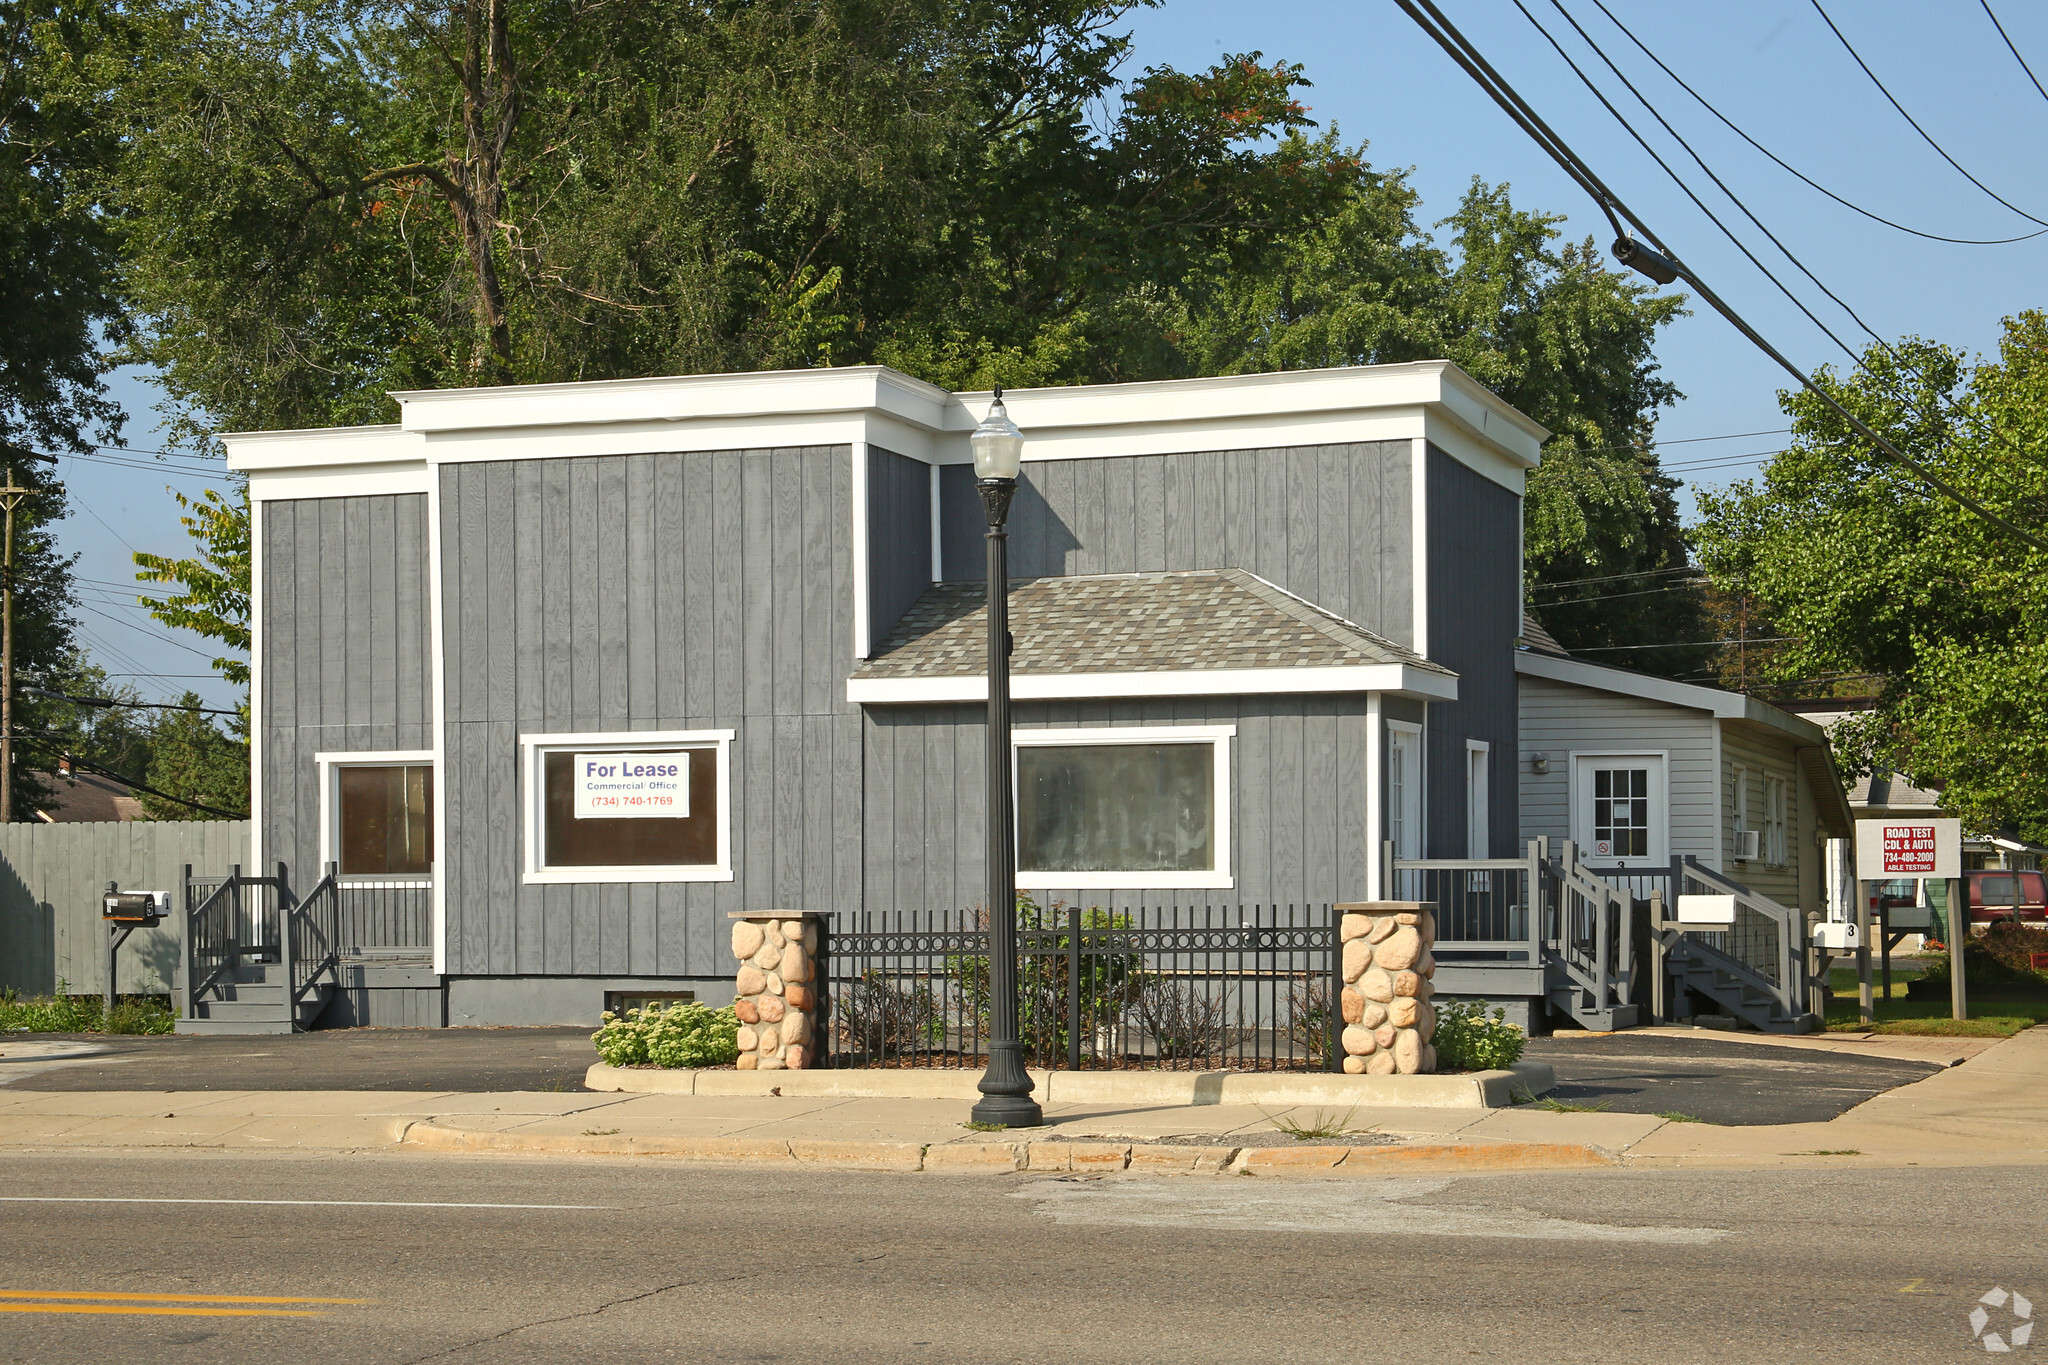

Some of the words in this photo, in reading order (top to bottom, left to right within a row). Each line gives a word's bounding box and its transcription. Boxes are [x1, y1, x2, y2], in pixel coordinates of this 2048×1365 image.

[587, 762, 616, 777] For
[622, 761, 678, 777] Lease
[649, 781, 677, 790] Office
[591, 797, 619, 808] (734)
[623, 796, 673, 806] 740-1769
[1886, 828, 1910, 838] ROAD
[1911, 828, 1932, 838] TEST
[1884, 840, 1902, 850] CDL
[1903, 840, 1911, 850] &
[1912, 839, 1934, 850] AUTO
[1884, 852, 1934, 862] 734-480-2000
[147, 902, 153, 916] 5
[165, 898, 170, 910] 1
[1848, 925, 1855, 937] 3
